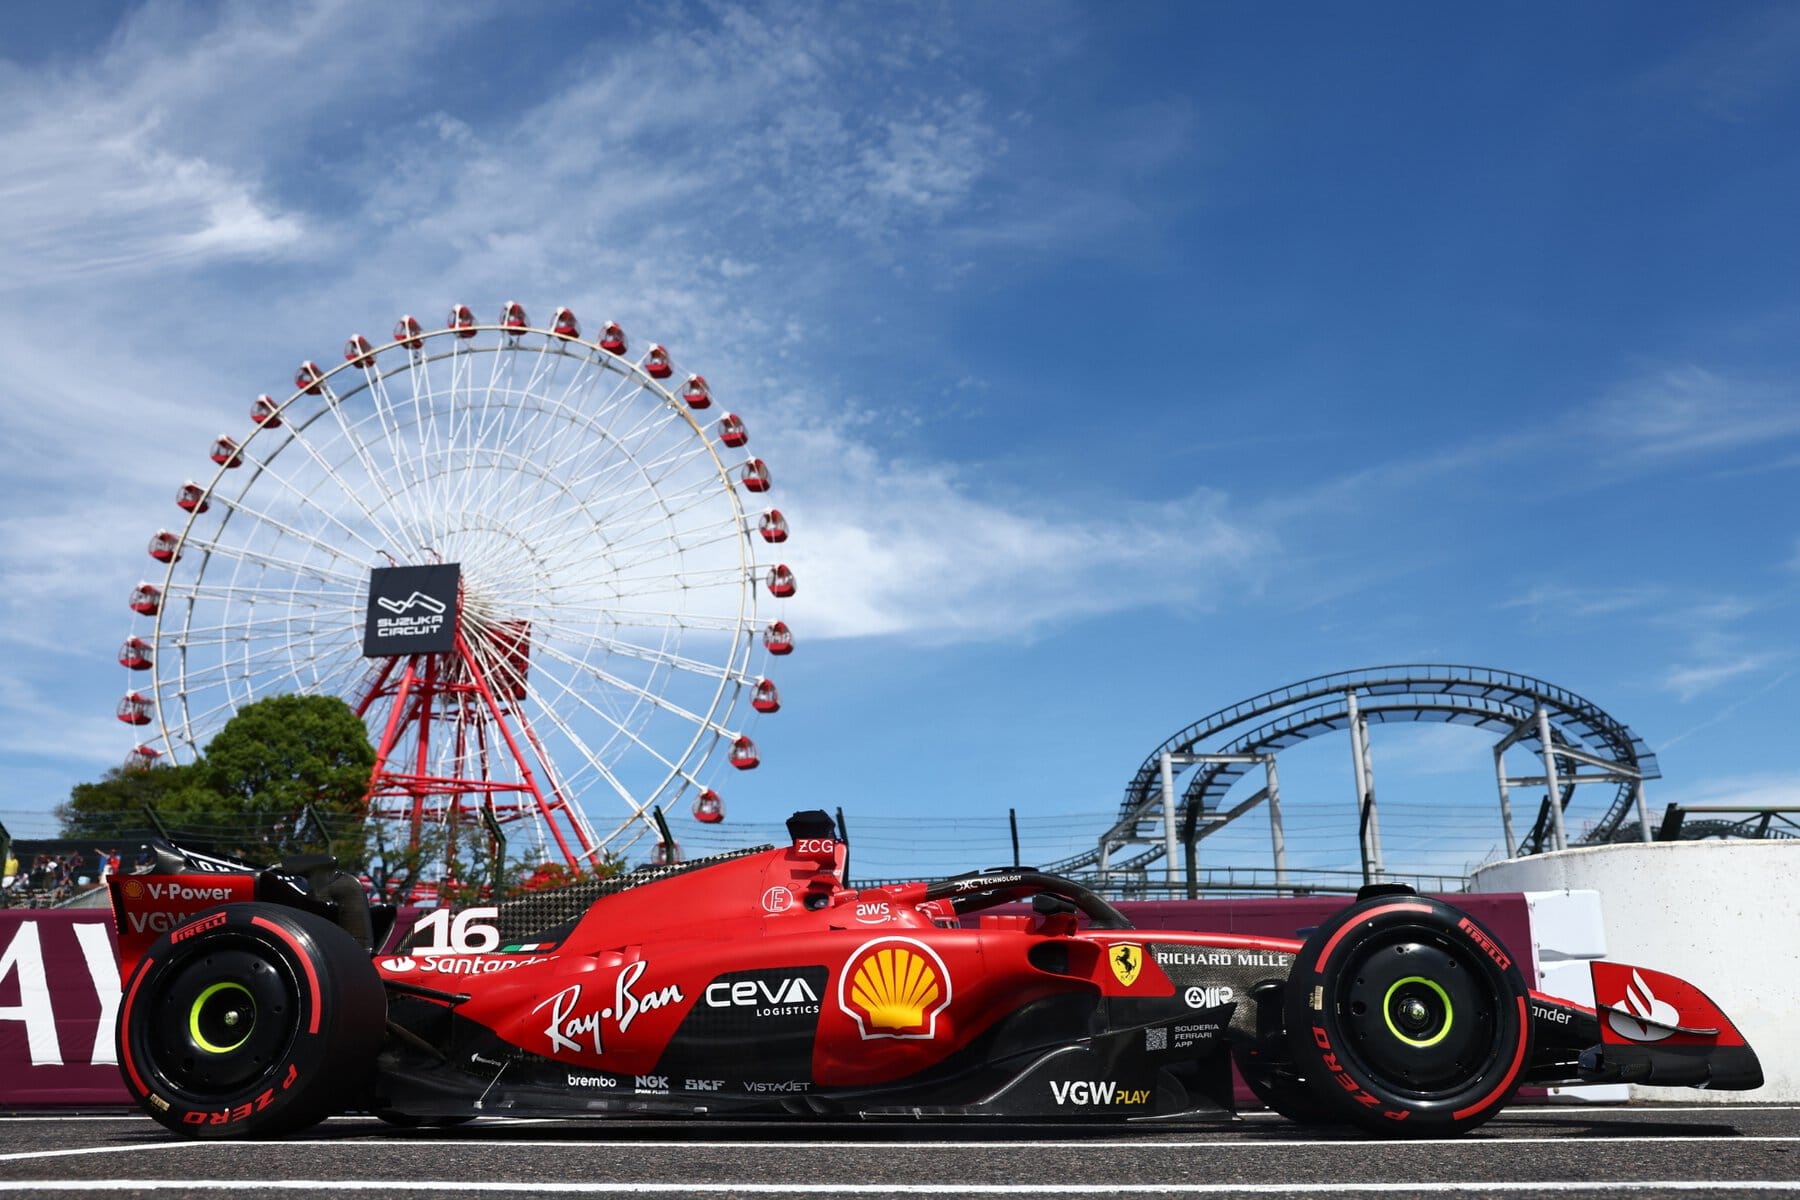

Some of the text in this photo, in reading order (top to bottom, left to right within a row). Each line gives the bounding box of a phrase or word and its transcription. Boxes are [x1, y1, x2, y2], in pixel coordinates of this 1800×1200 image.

[377, 615, 443, 627] SUZUKA
[377, 625, 441, 637] CIRCUIT
[798, 839, 834, 853] ZCG
[980, 875, 1022, 886] TECHNOLOGY
[147, 883, 232, 900] V-Power
[856, 902, 890, 916] aws
[171, 911, 228, 945] PIRELLI
[411, 906, 500, 956] 16
[1458, 917, 1511, 971] PIRELLI
[420, 954, 560, 975] Santander
[1157, 952, 1289, 967] RICHARD MILLE
[756, 1005, 820, 1017] LOGISTICS
[1174, 1023, 1220, 1032] SCUDERIA
[1174, 1032, 1212, 1040] FERRARI
[1174, 1041, 1193, 1049] APP
[1312, 1026, 1411, 1121] P ZERO
[568, 1074, 617, 1088] brembo
[635, 1075, 669, 1089] NGK
[685, 1079, 725, 1091] SKF
[183, 1063, 298, 1125] P ZERO
[1115, 1090, 1150, 1105] PLAY
